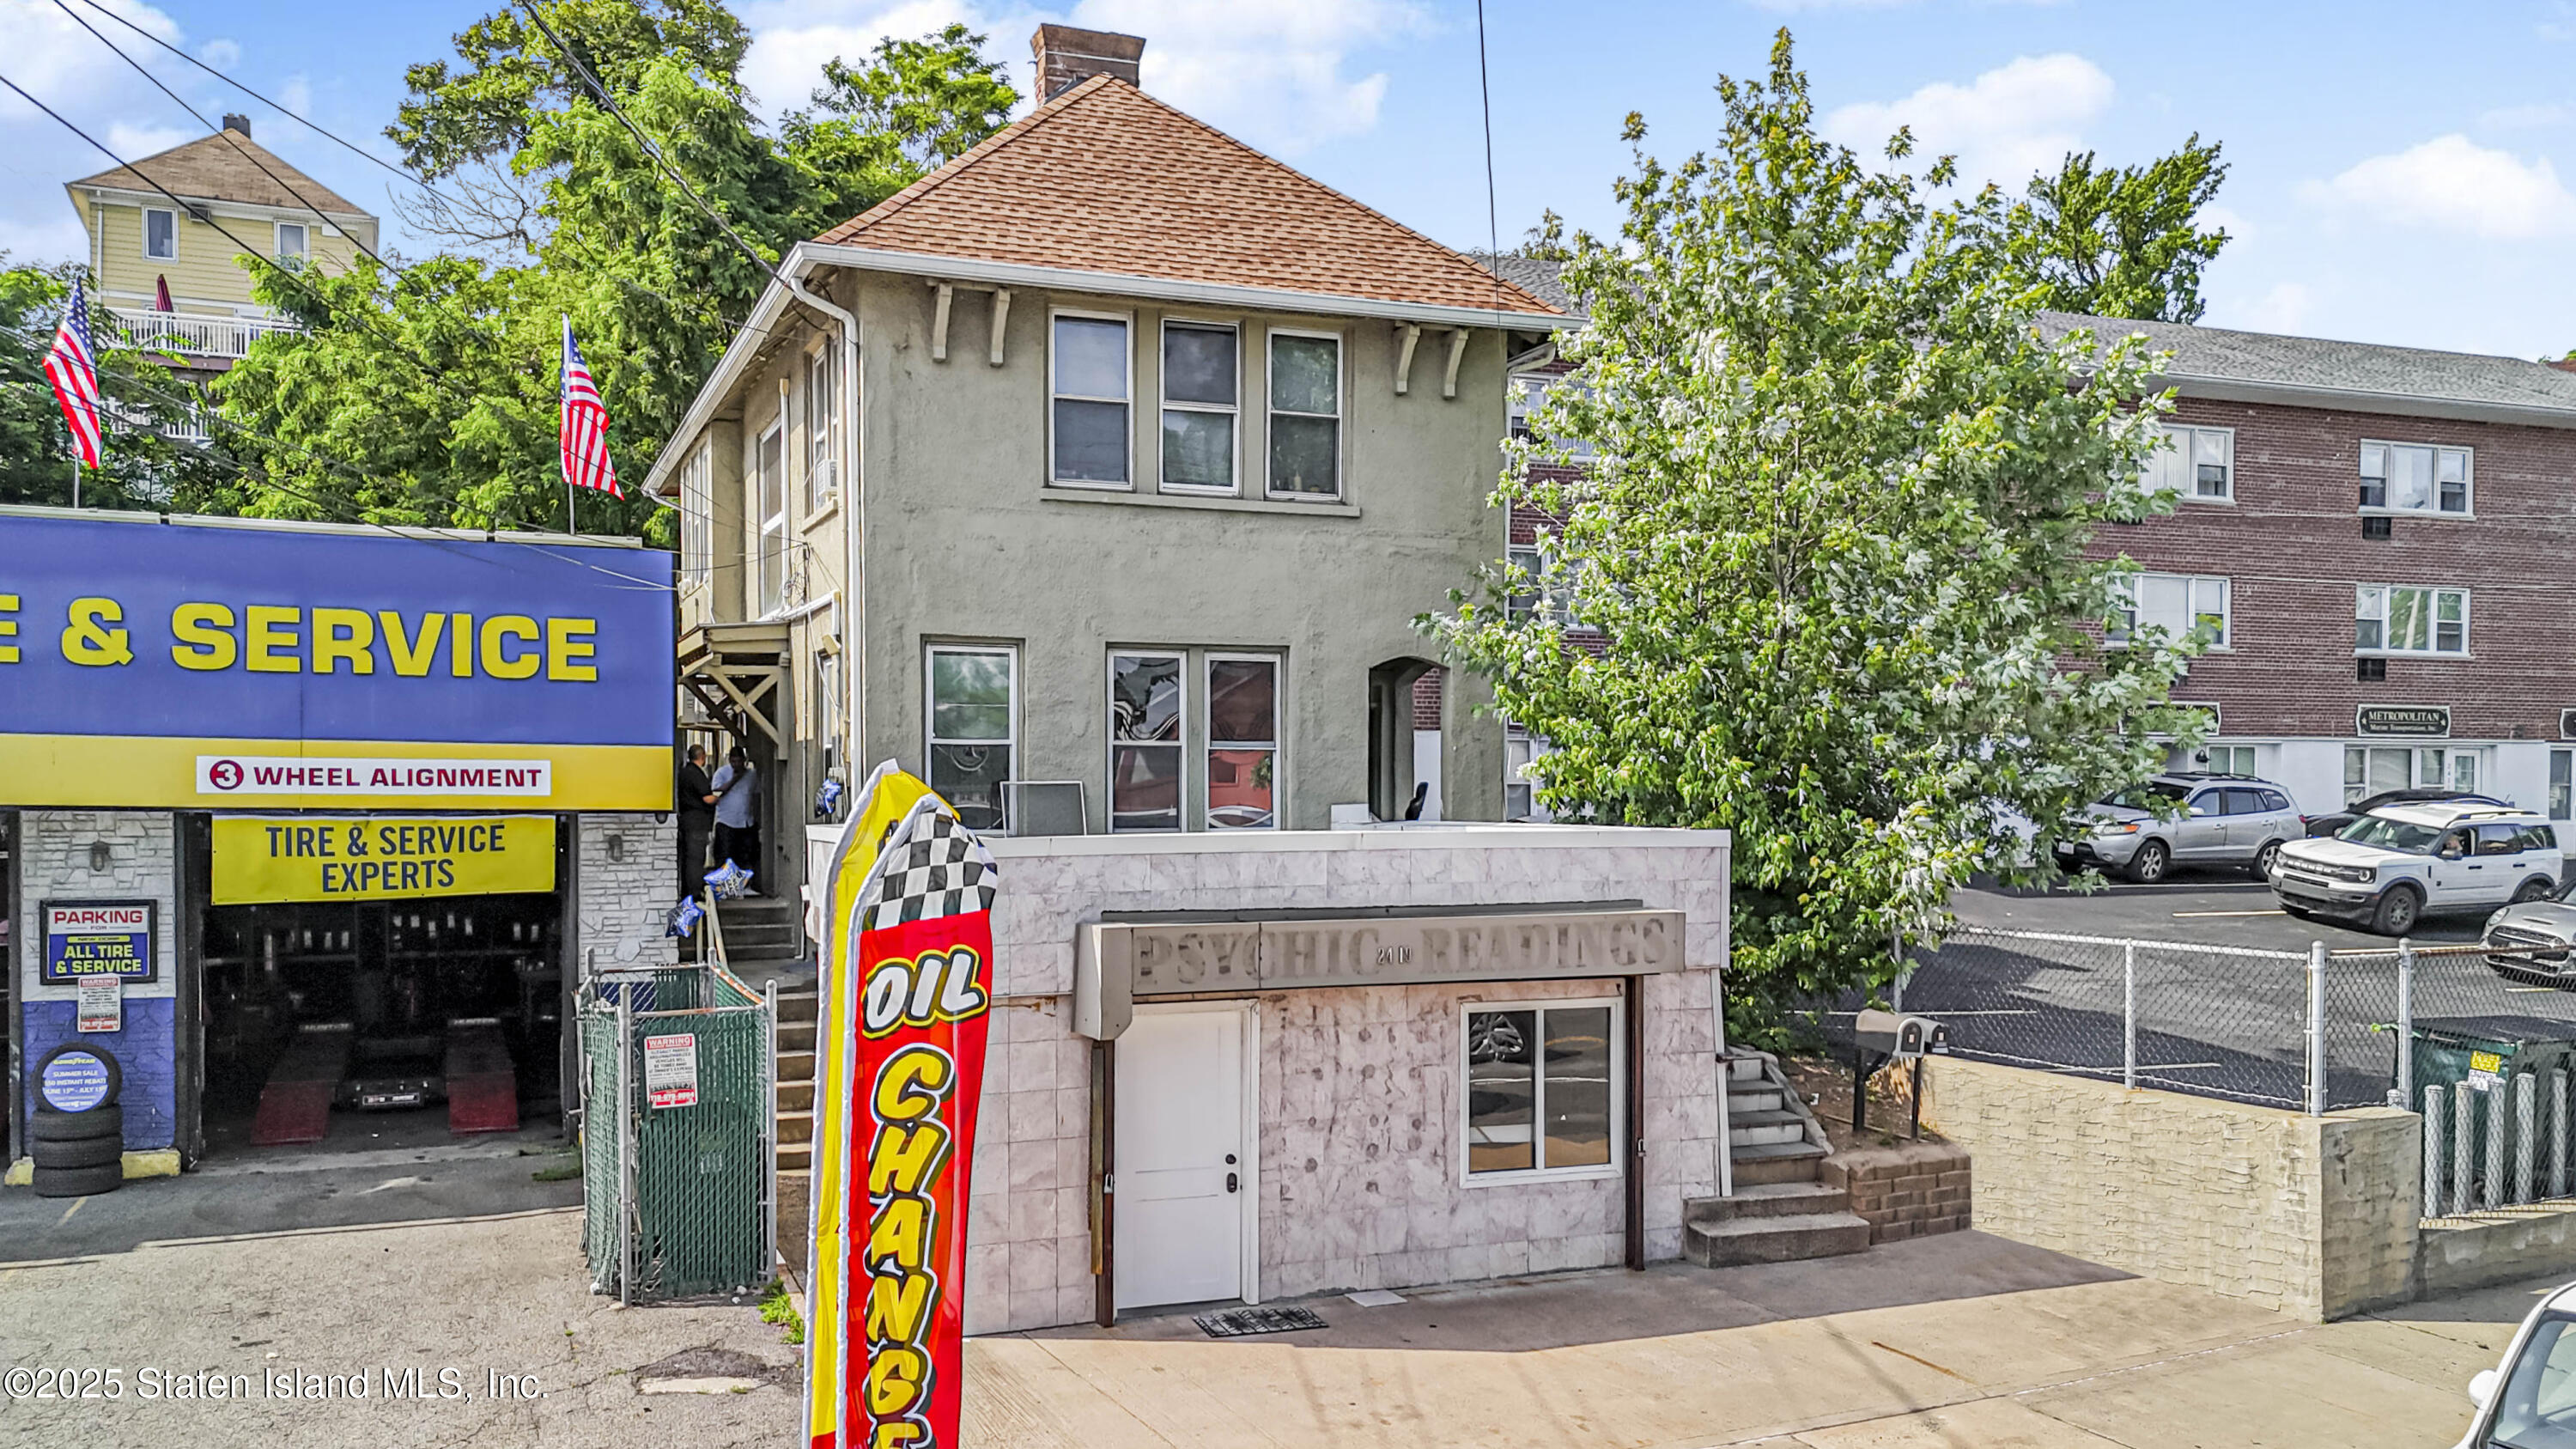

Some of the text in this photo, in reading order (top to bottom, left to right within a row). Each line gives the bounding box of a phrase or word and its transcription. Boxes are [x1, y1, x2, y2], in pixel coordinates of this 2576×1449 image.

[62, 597, 134, 667] &
[172, 603, 598, 682] SERVICE
[2368, 711, 2439, 721] METROPOLITAN
[253, 766, 361, 787] WHEEL
[369, 767, 542, 788] ALIGNMENT
[265, 825, 506, 857] TIRE & SERVICE
[323, 859, 454, 893] EXPERTS
[54, 910, 143, 924] PARKING
[64, 944, 134, 959] ALL TIRE
[1136, 917, 1668, 985] PSYCHIC READINGS
[55, 959, 143, 974] & SERVICE
[864, 949, 984, 1034] OIL
[649, 1037, 690, 1047] WARNING
